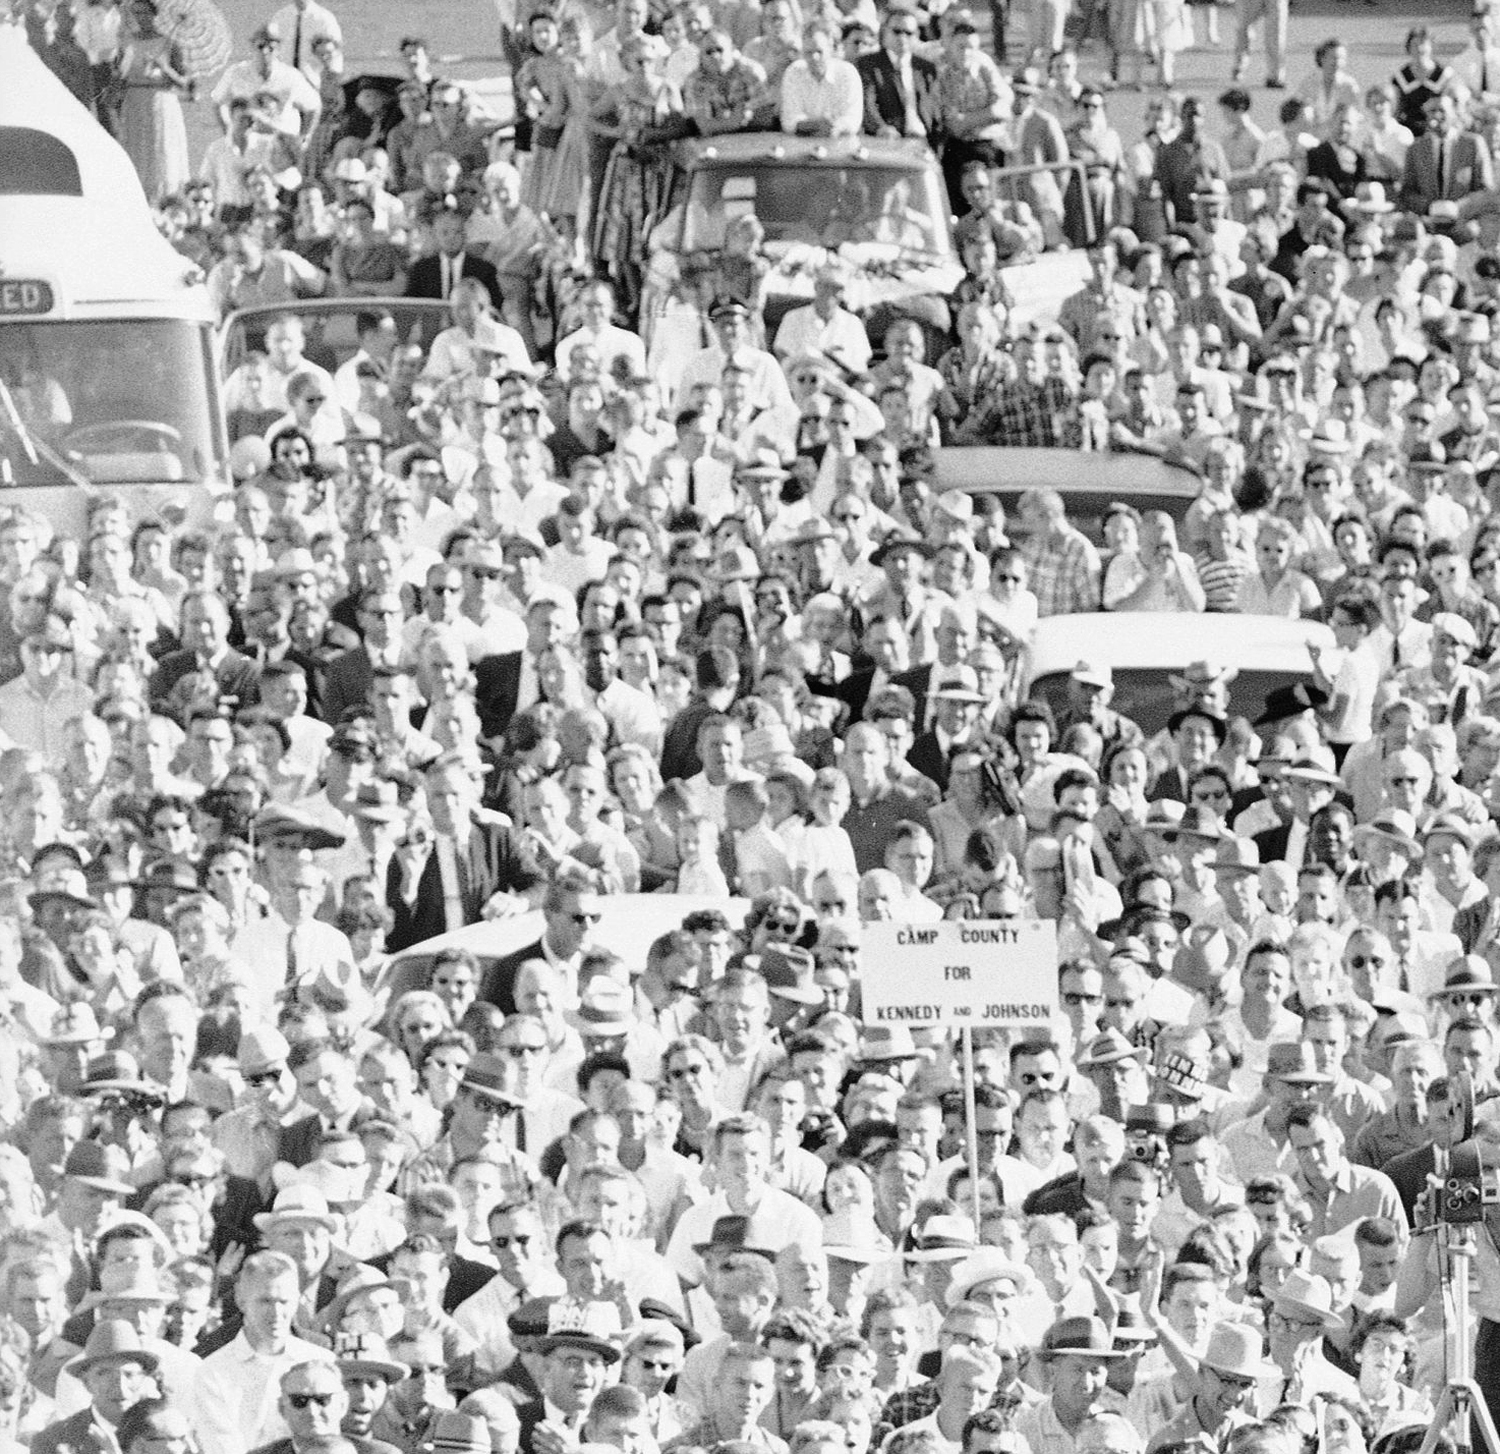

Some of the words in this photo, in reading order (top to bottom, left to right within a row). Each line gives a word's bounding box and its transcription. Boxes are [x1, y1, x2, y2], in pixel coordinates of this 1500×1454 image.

[3, 284, 40, 308] ED
[897, 930, 939, 945] CAMP
[961, 929, 1019, 944] COUNTY
[944, 966, 971, 980] FOR
[877, 1005, 942, 1020] KENNEDY
[953, 1007, 971, 1016] AND
[982, 1004, 1051, 1019] JOHNSON
